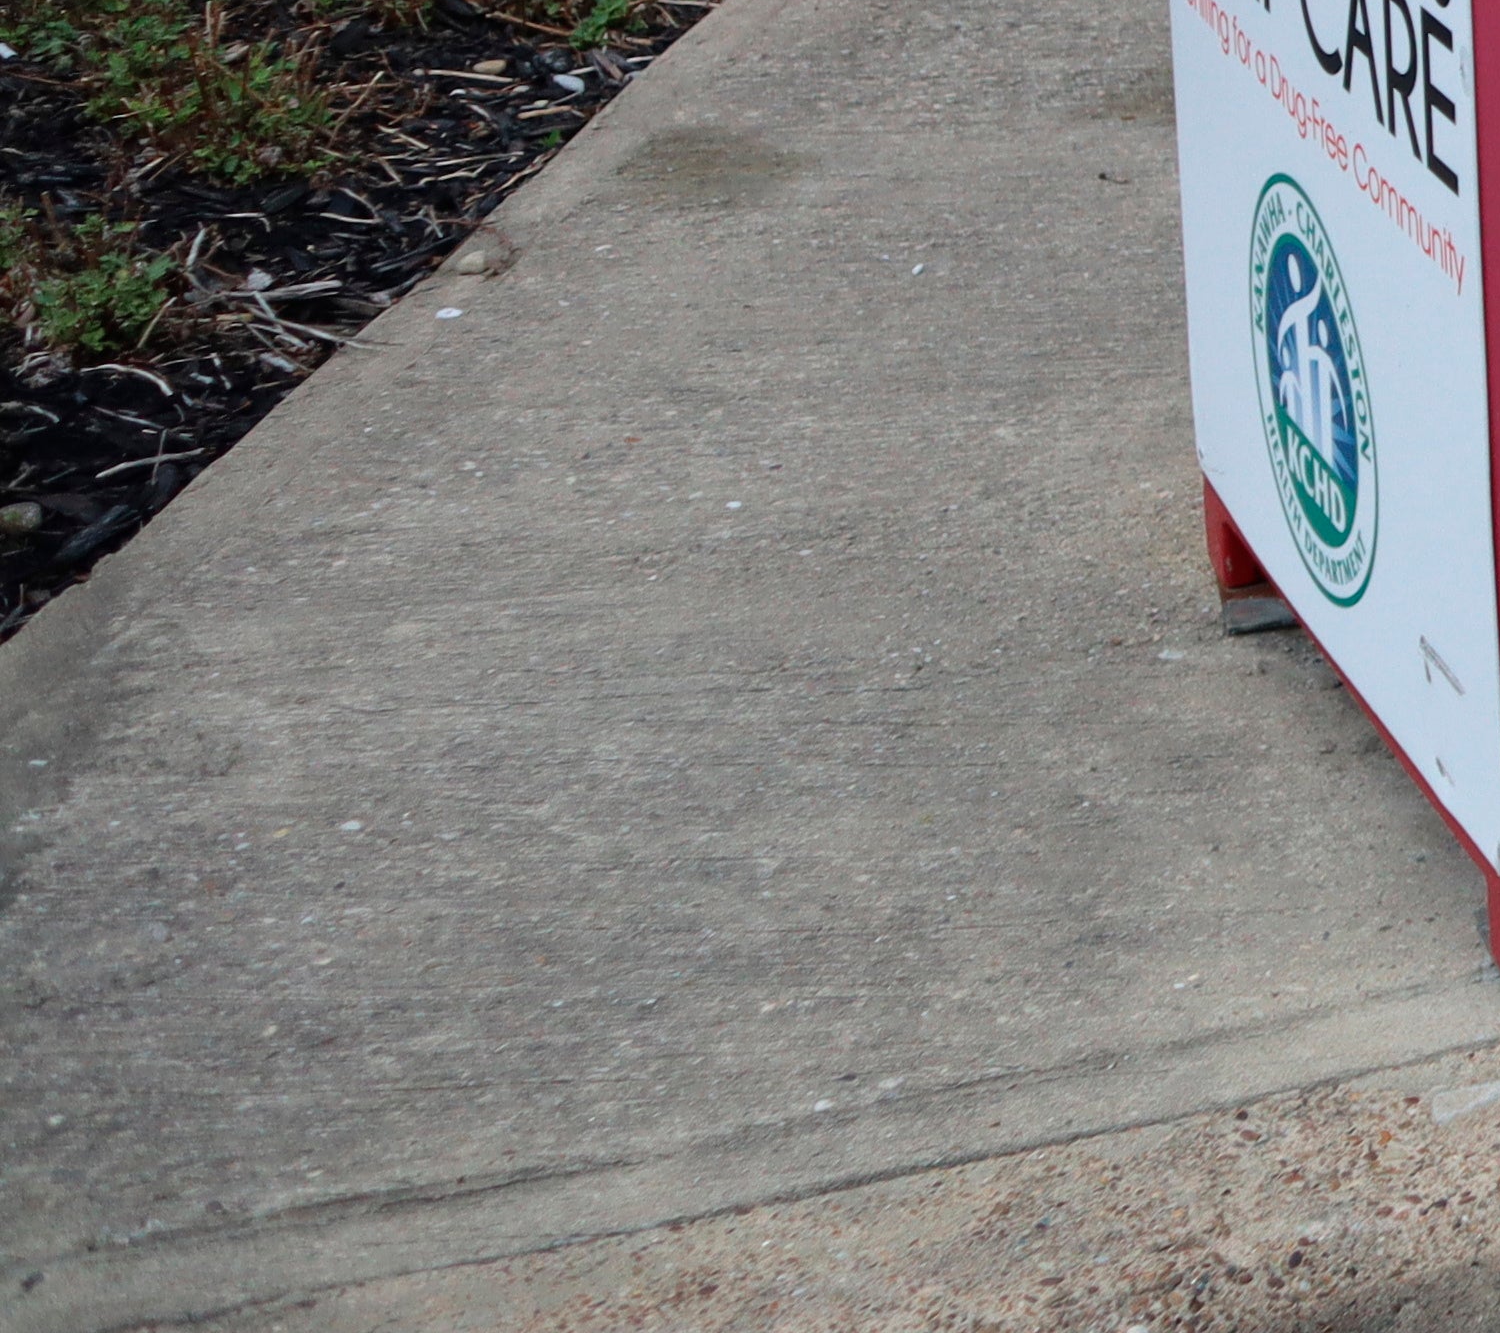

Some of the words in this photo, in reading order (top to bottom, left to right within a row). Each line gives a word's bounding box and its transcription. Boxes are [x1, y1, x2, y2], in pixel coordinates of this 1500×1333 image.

[1233, 15, 1251, 70] for
[1256, 49, 1266, 87] a
[1270, 51, 1348, 171] Drug-Free
[1353, 143, 1464, 295] Community
[1254, 192, 1285, 334] KANAWHA
[1296, 203, 1372, 463] CHARLESTON
[1266, 412, 1302, 529] HEALTH
[1304, 531, 1366, 587] DEPARTMENT
[1282, 424, 1346, 533] KCHD
